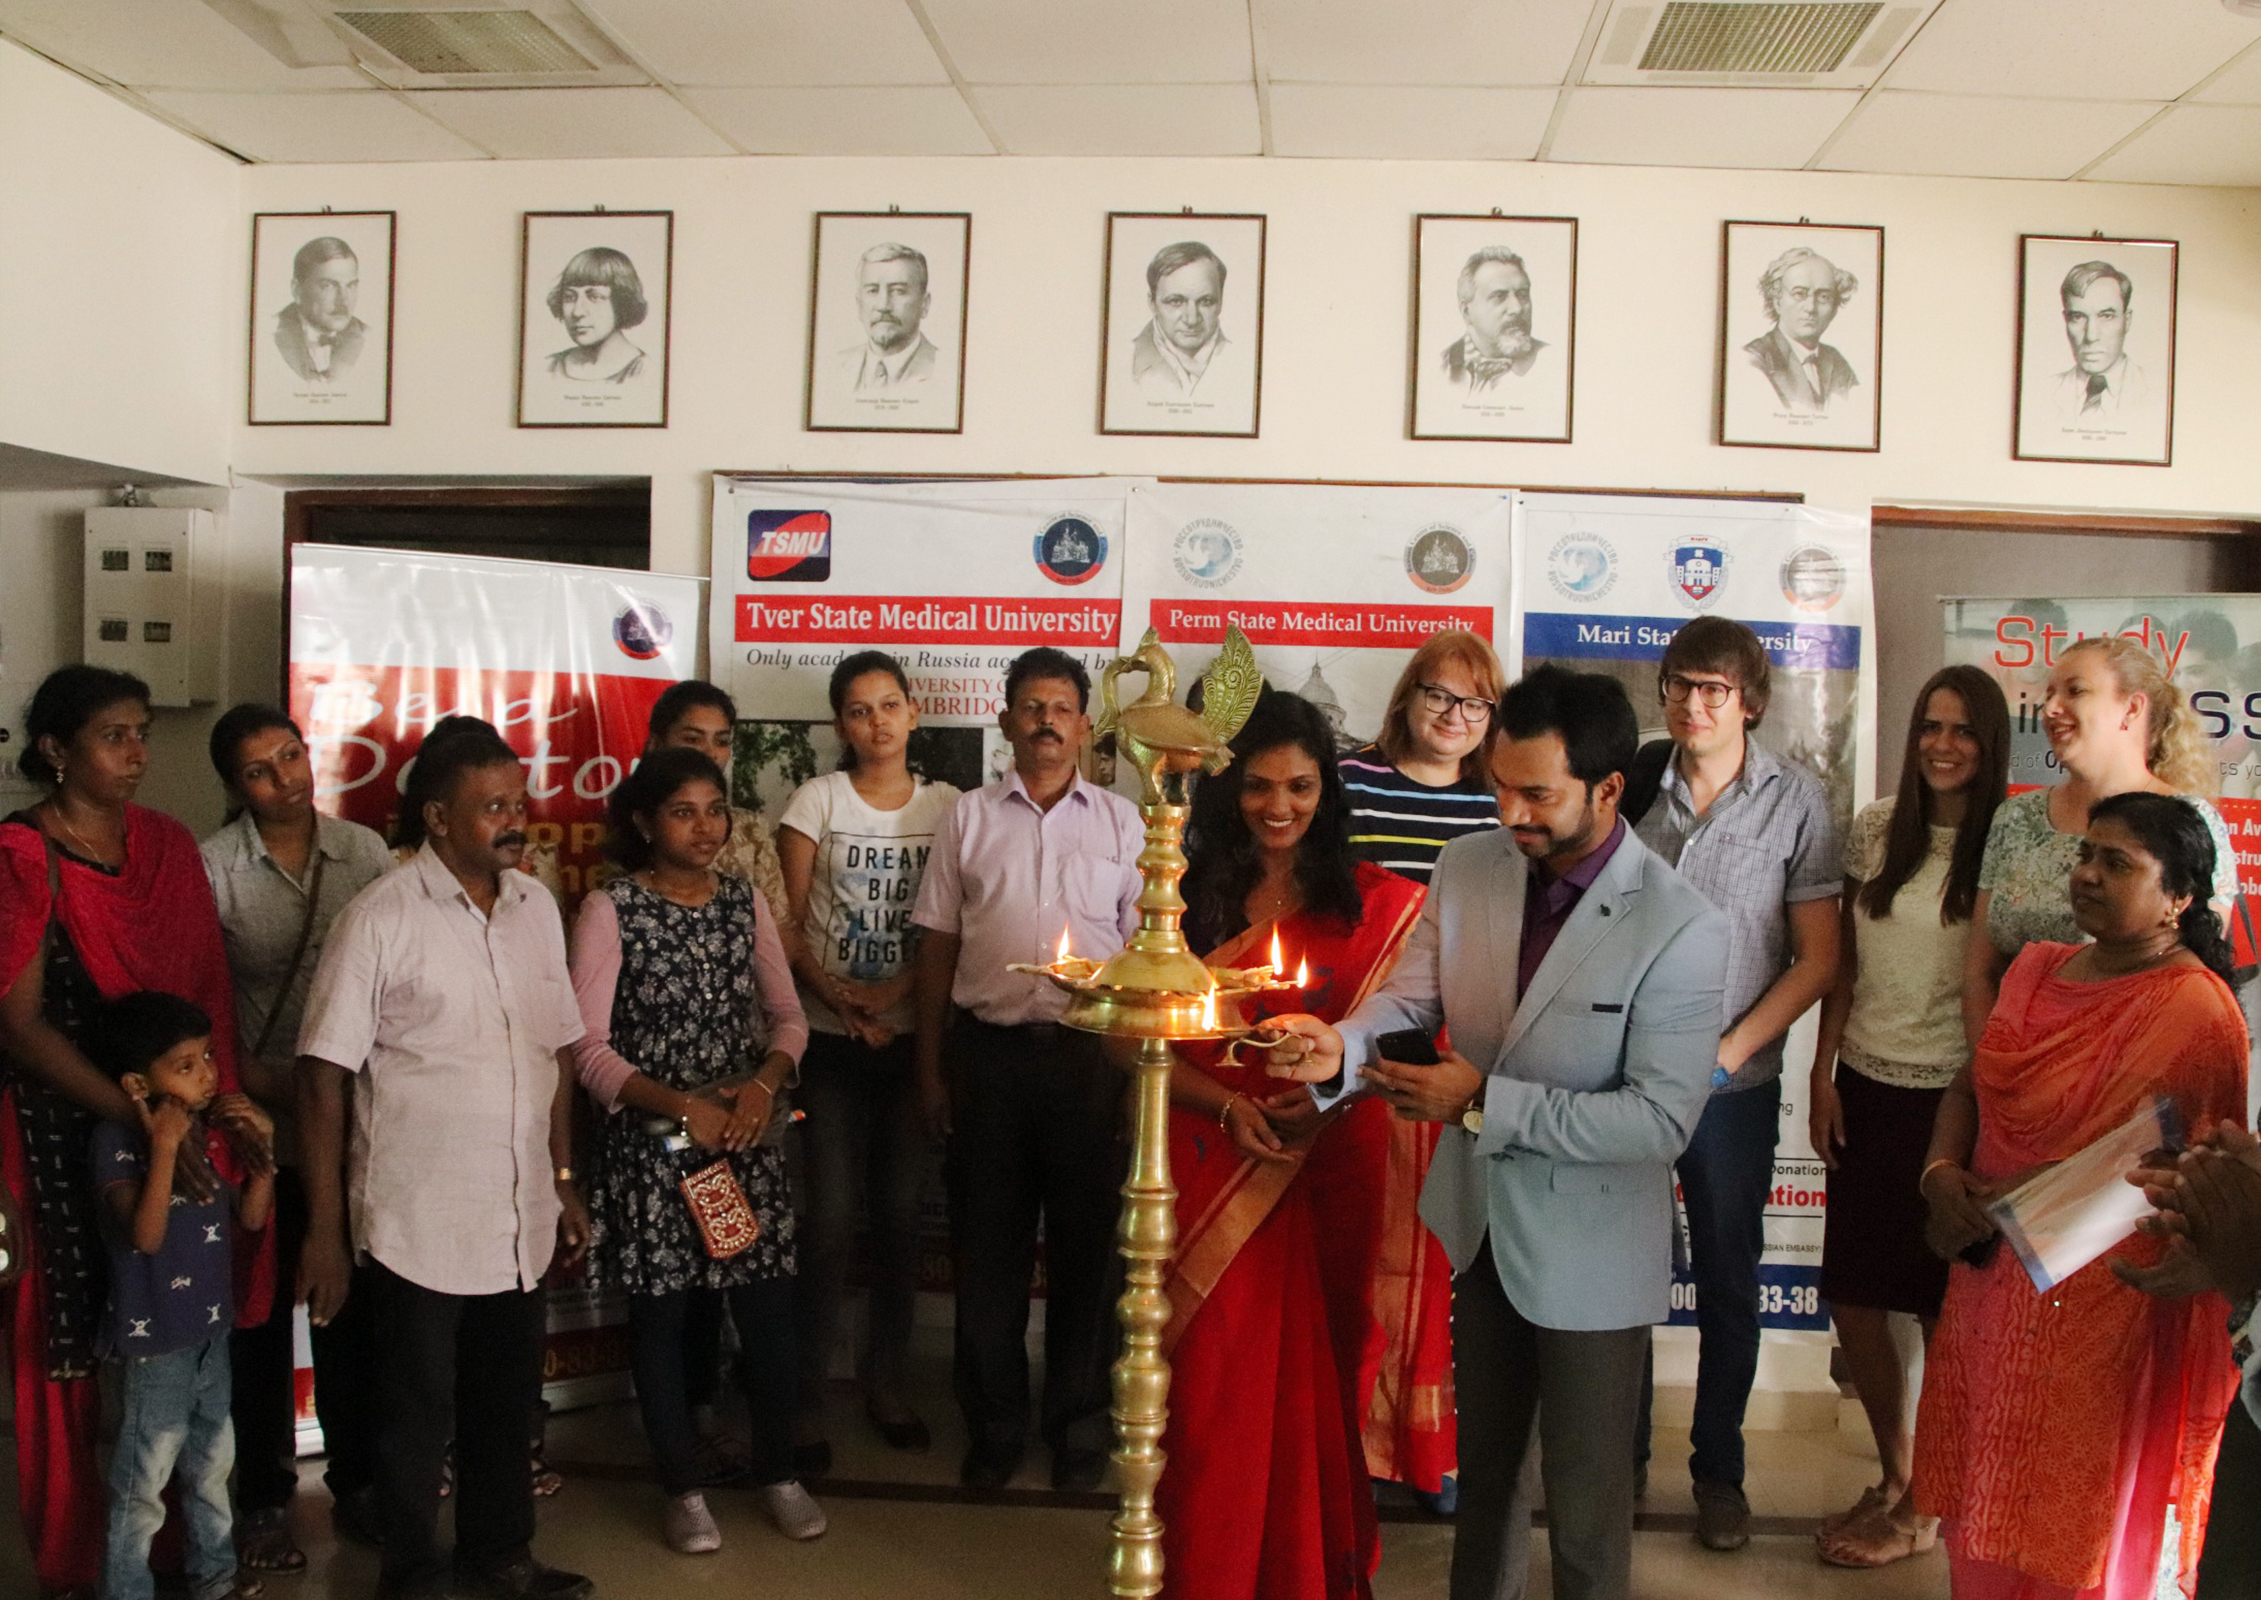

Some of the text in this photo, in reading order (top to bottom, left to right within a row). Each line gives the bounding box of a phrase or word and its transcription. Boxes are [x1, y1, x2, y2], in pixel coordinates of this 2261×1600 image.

[761, 531, 826, 555] TSMU
[747, 602, 1117, 640] Tver State Medical University
[1169, 609, 1221, 628] Perm
[1227, 610, 1277, 630] State
[1282, 611, 1363, 632] Medical
[1577, 624, 1631, 645] Mari
[1637, 626, 1678, 646] Sta
[747, 648, 792, 670] Only
[798, 649, 845, 667] acad
[917, 651, 981, 668] Russia
[908, 677, 993, 694] IVERSITY
[868, 878, 910, 902] BIG
[859, 909, 913, 932] LIVE
[1763, 1244, 1784, 1253] SSIAN
